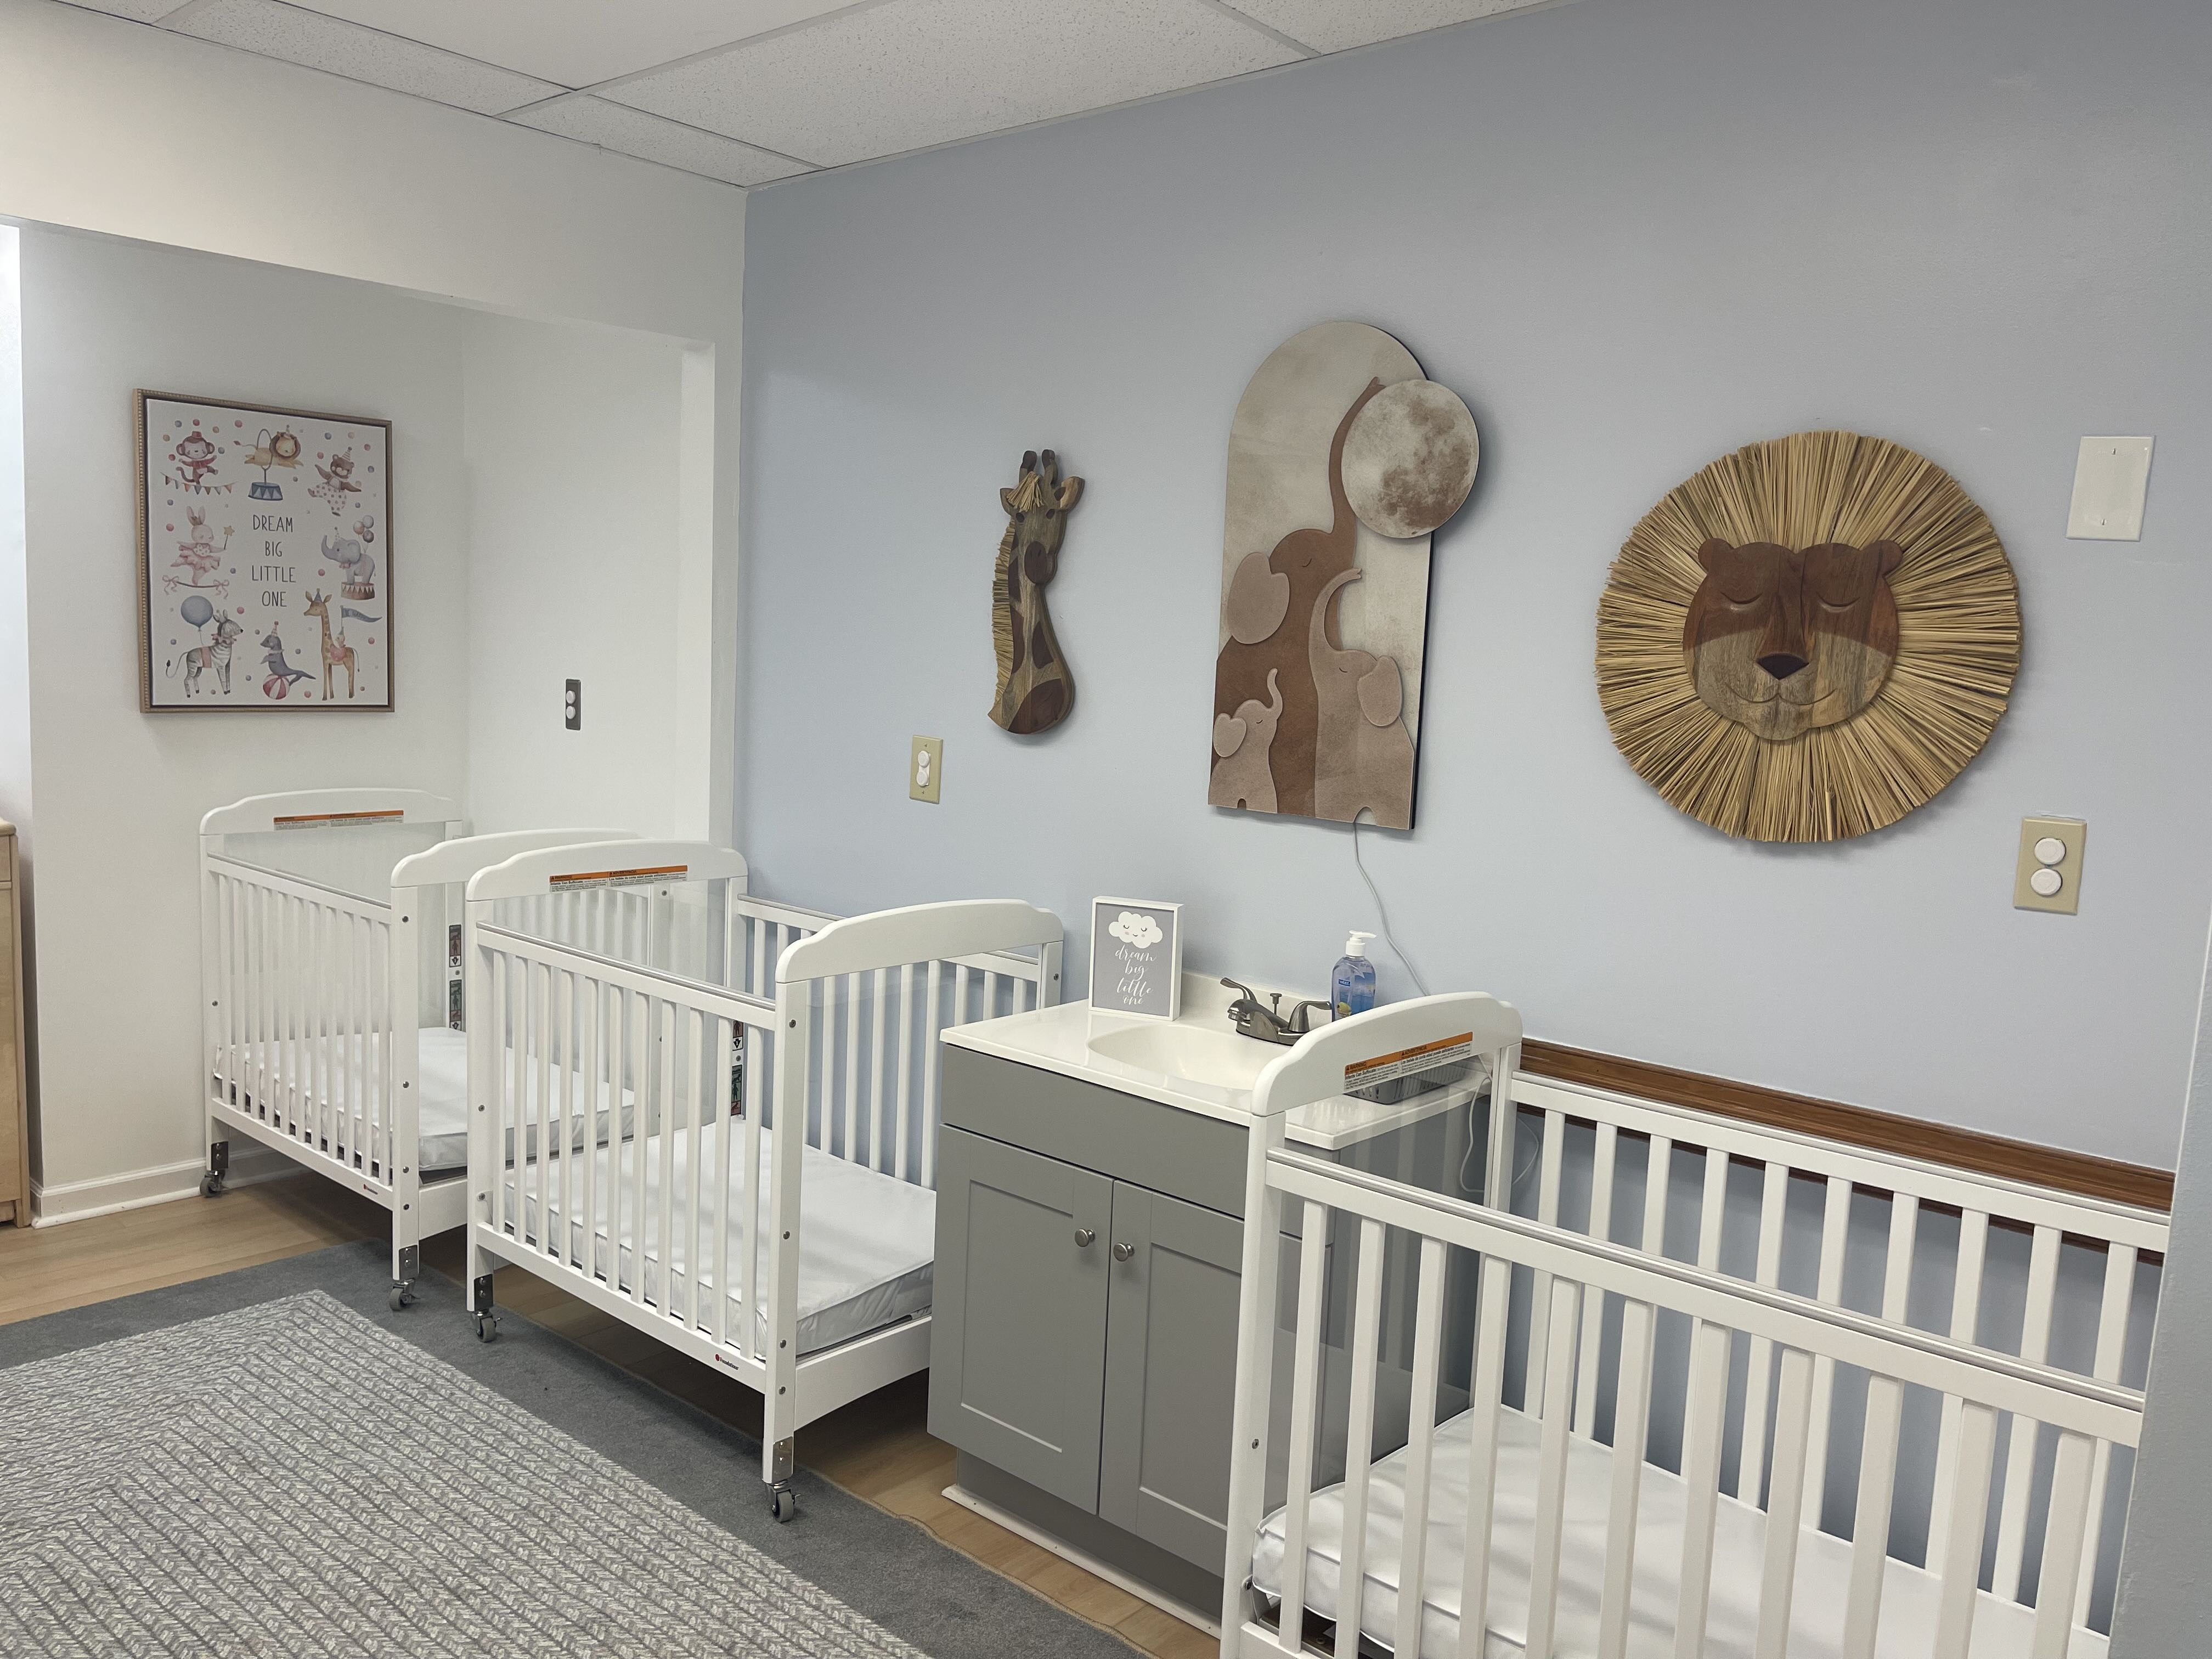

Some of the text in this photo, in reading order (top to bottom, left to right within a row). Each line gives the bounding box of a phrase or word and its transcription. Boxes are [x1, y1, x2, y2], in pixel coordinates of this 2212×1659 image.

[253, 514, 293, 533] DREAM
[265, 540, 283, 557] BIG
[252, 565, 296, 583] LITTLE
[262, 590, 287, 607] ONE
[1115, 944, 1156, 962] dream
[1125, 959, 1147, 981] big
[1116, 978, 1154, 997] little
[1123, 995, 1145, 1005] one
